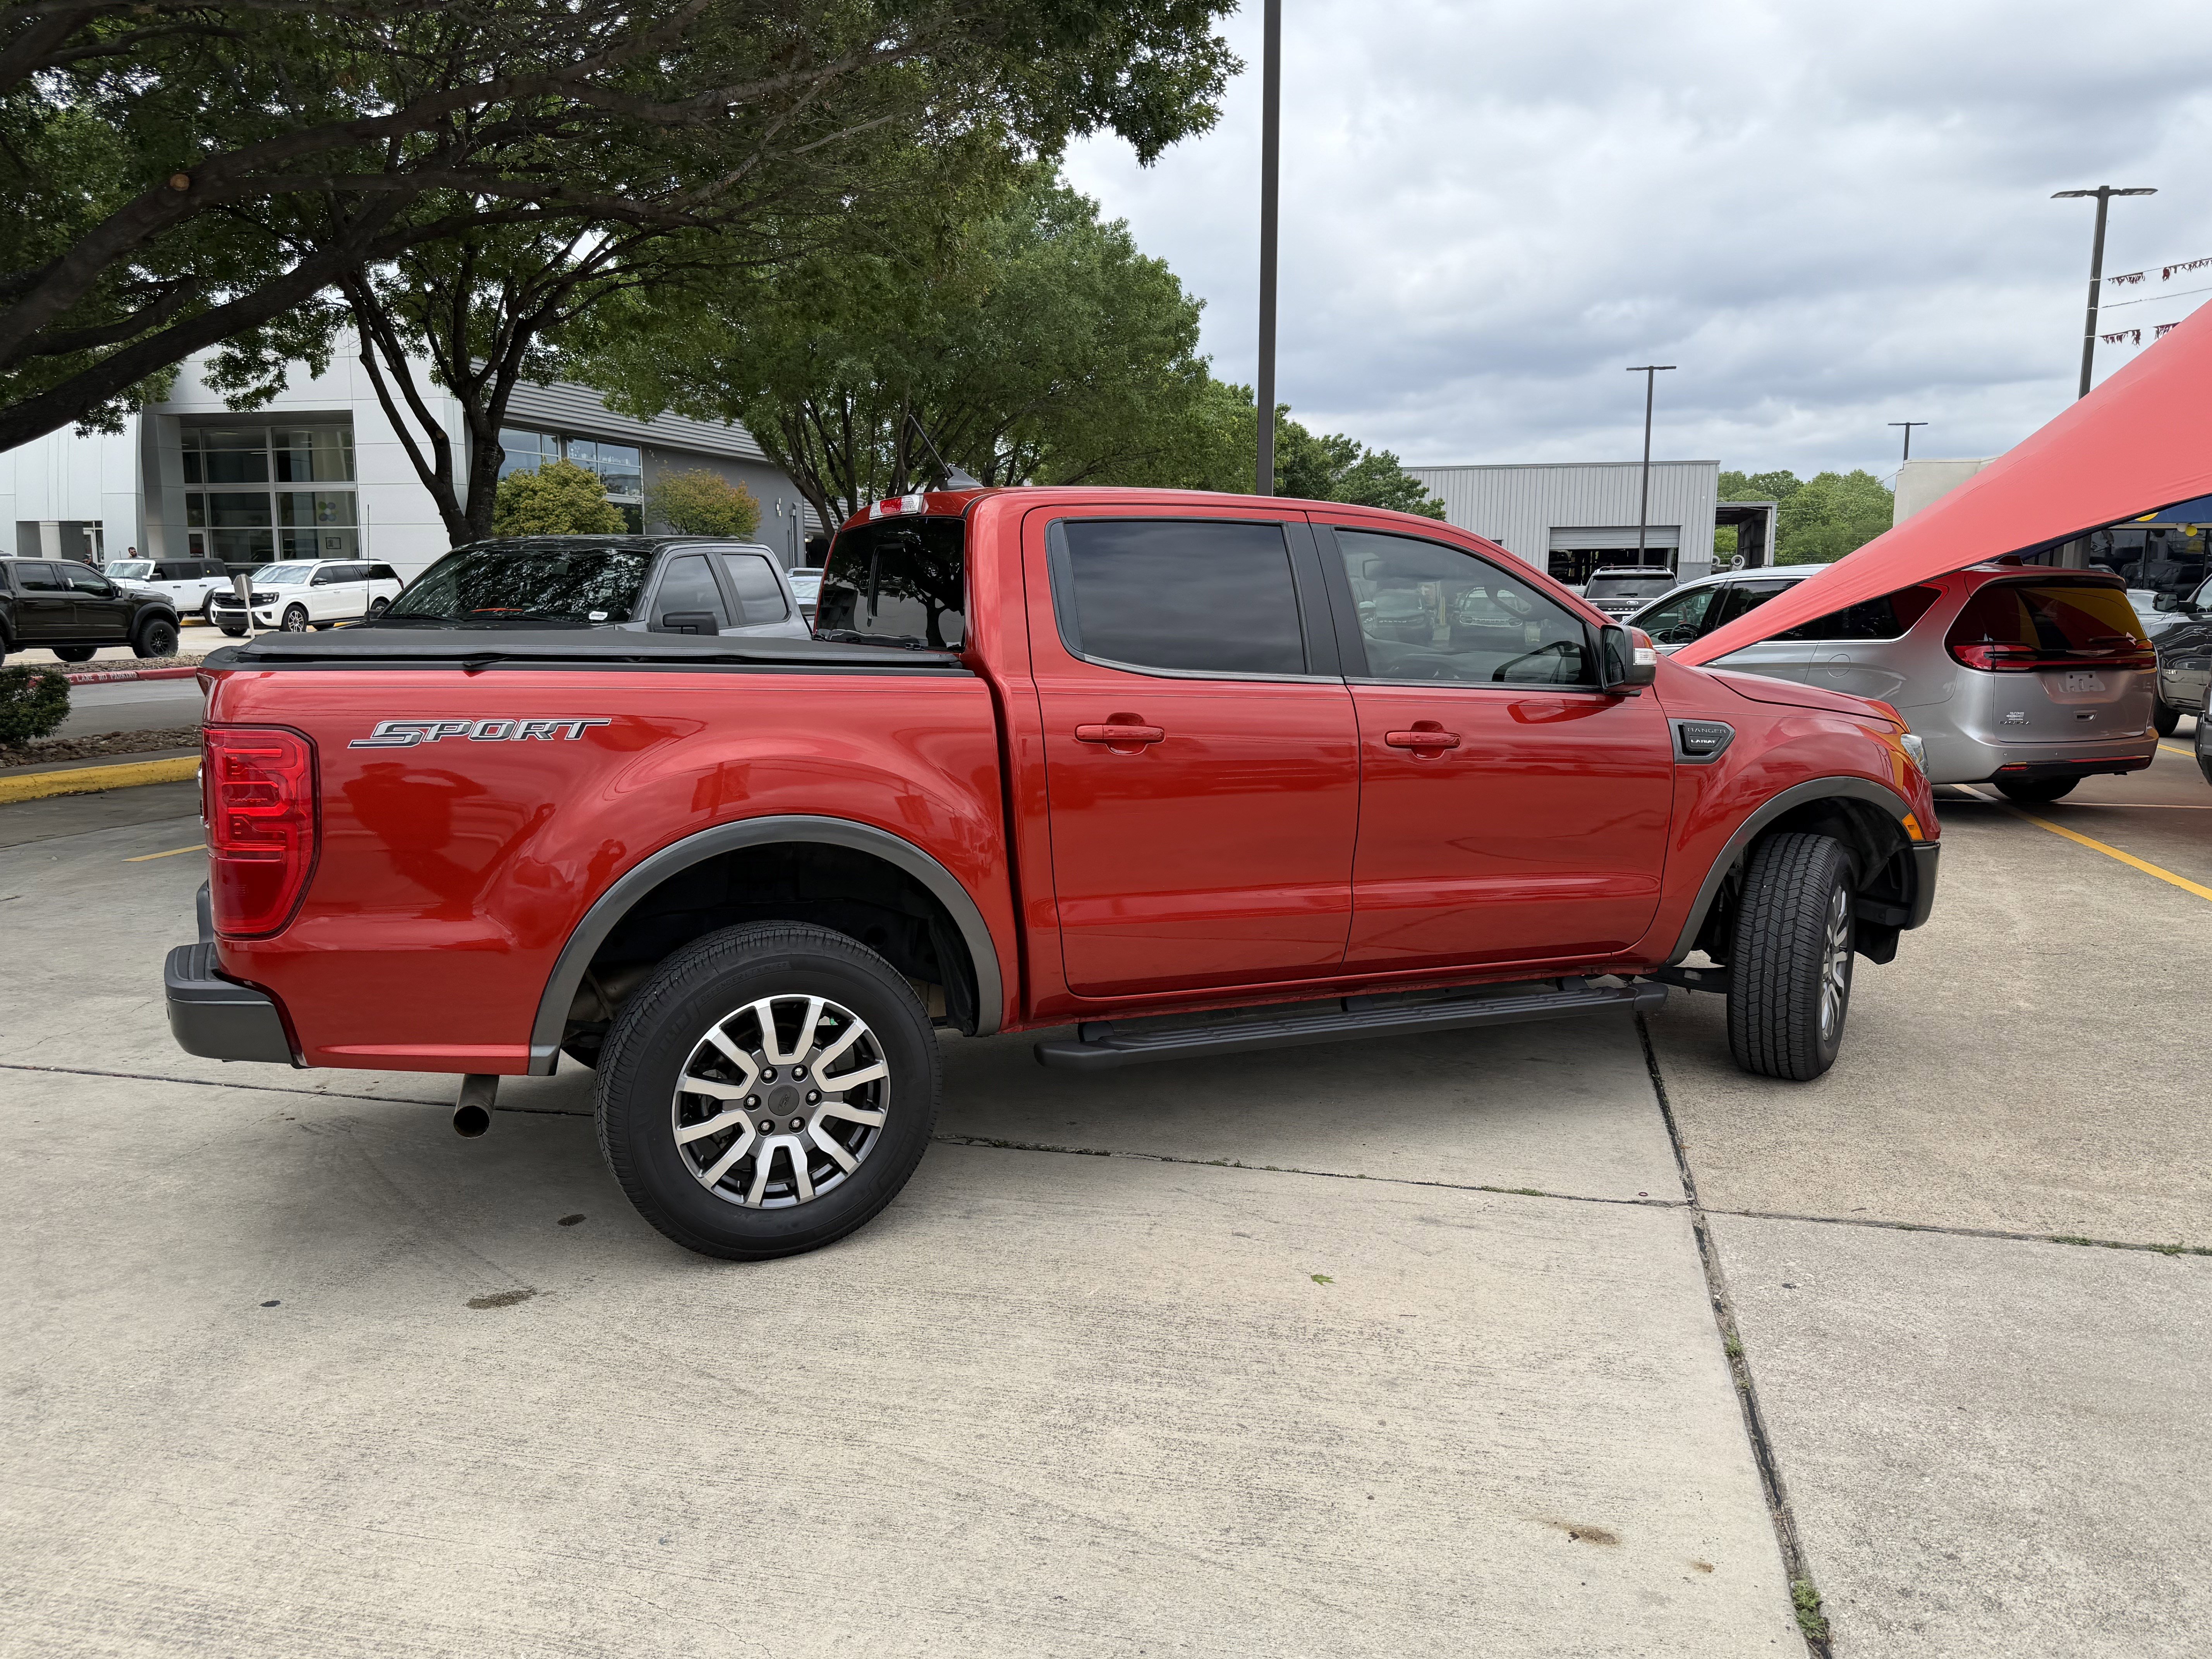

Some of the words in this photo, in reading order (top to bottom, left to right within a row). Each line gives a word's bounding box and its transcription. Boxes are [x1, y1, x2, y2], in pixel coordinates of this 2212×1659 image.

[110, 672, 138, 680] PARKING
[347, 718, 612, 749] SPORT
[700, 974, 744, 1001] DEFENDER
